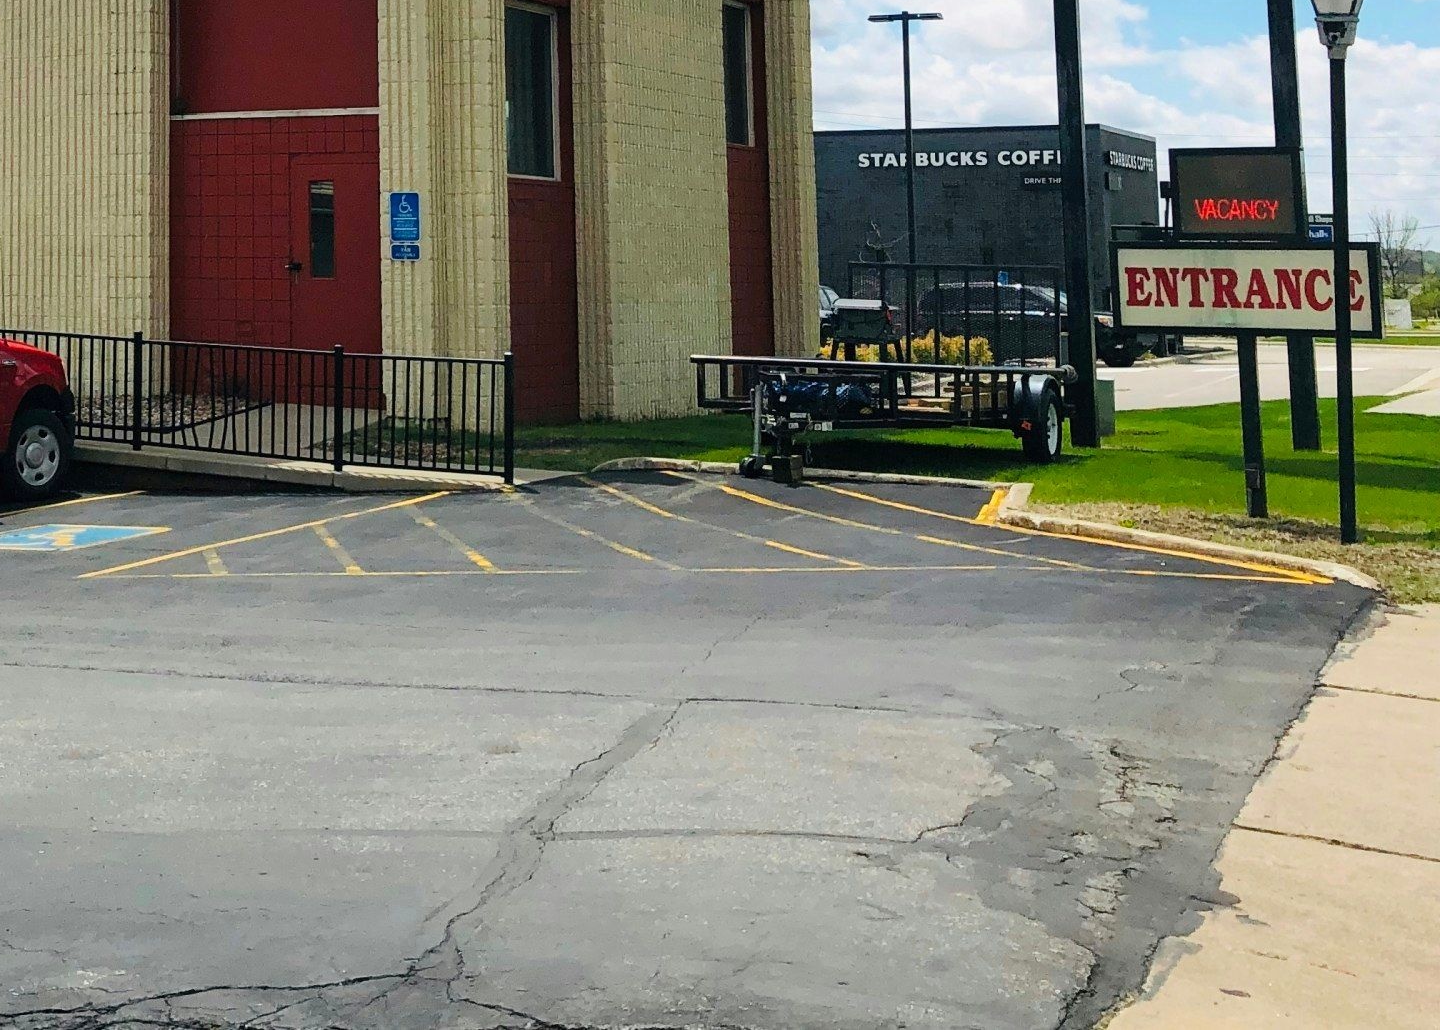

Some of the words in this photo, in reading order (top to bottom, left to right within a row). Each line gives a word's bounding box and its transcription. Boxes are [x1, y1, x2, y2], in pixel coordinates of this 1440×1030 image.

[997, 150, 1061, 166] COFF
[1194, 199, 1280, 220] VACANCY
[1308, 229, 1329, 239] halls
[1124, 266, 1365, 312] ENTRANCE
